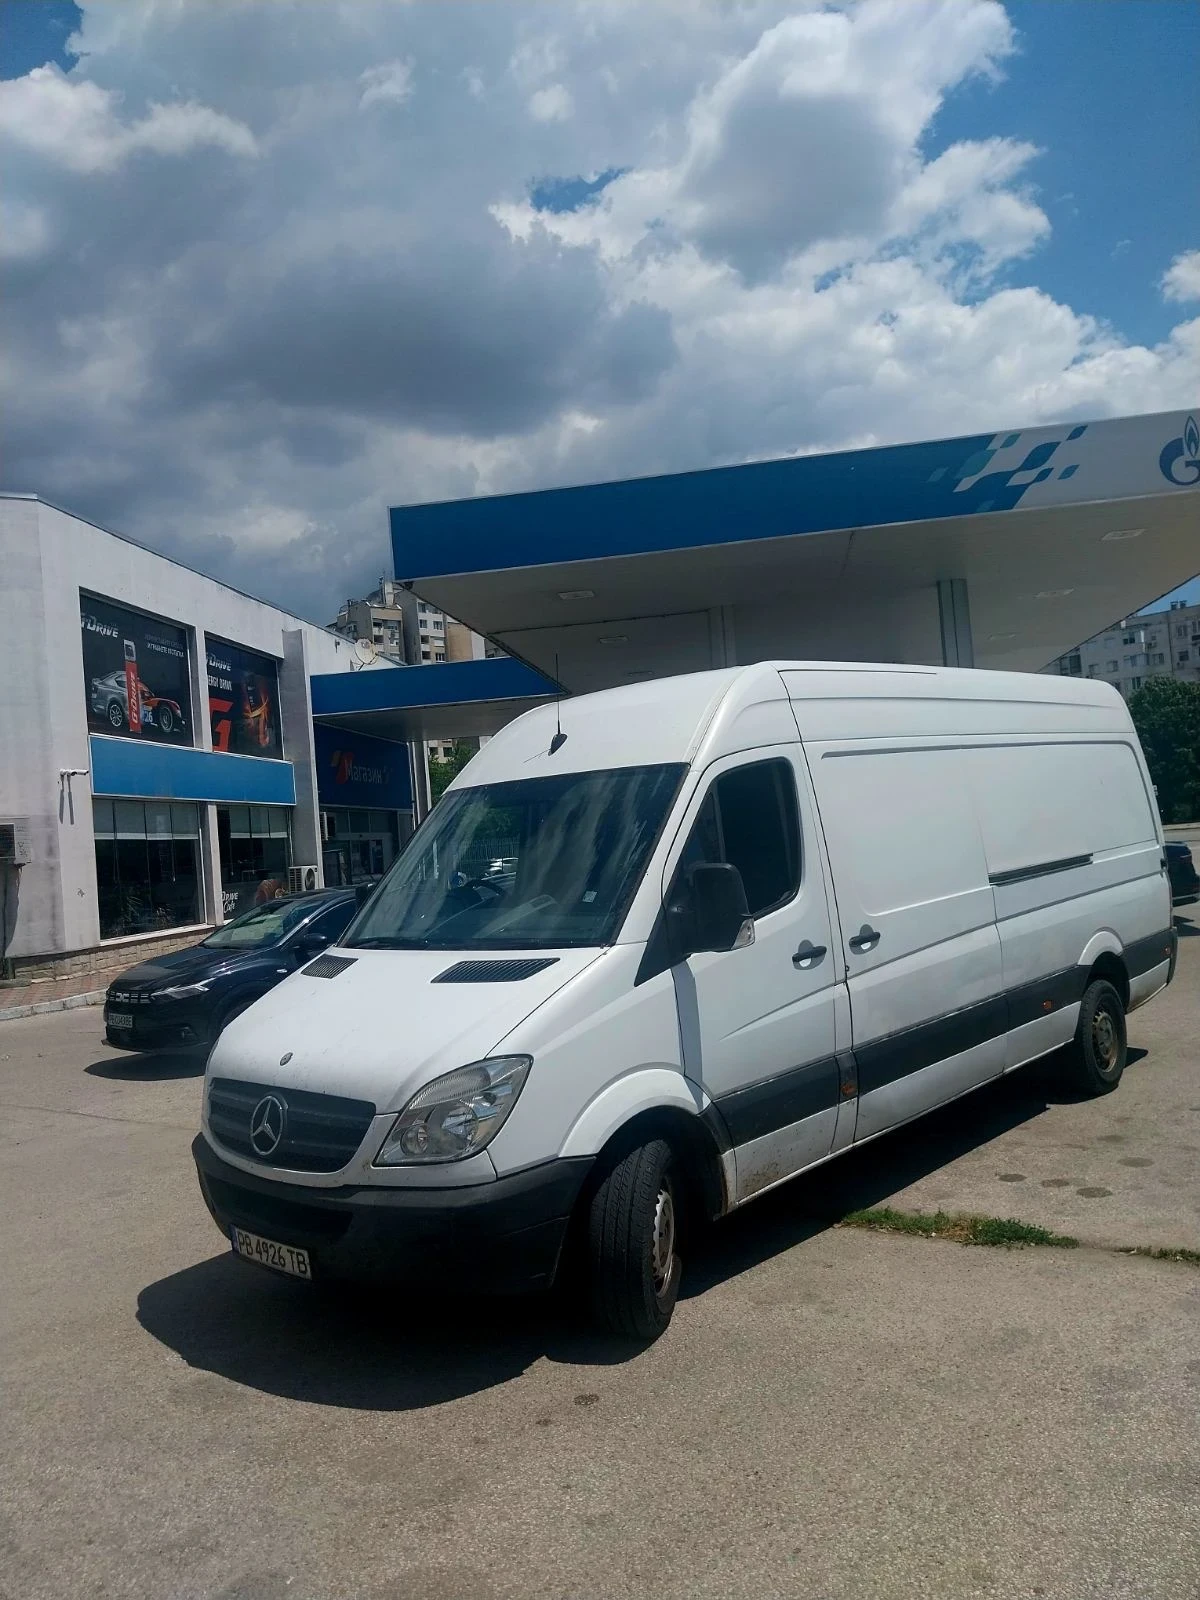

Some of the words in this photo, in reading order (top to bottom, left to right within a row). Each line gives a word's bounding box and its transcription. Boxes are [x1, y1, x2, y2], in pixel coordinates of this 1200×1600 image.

[238, 1232, 254, 1256] PB
[256, 1239, 286, 1268] 4926
[287, 1248, 308, 1274] TB
